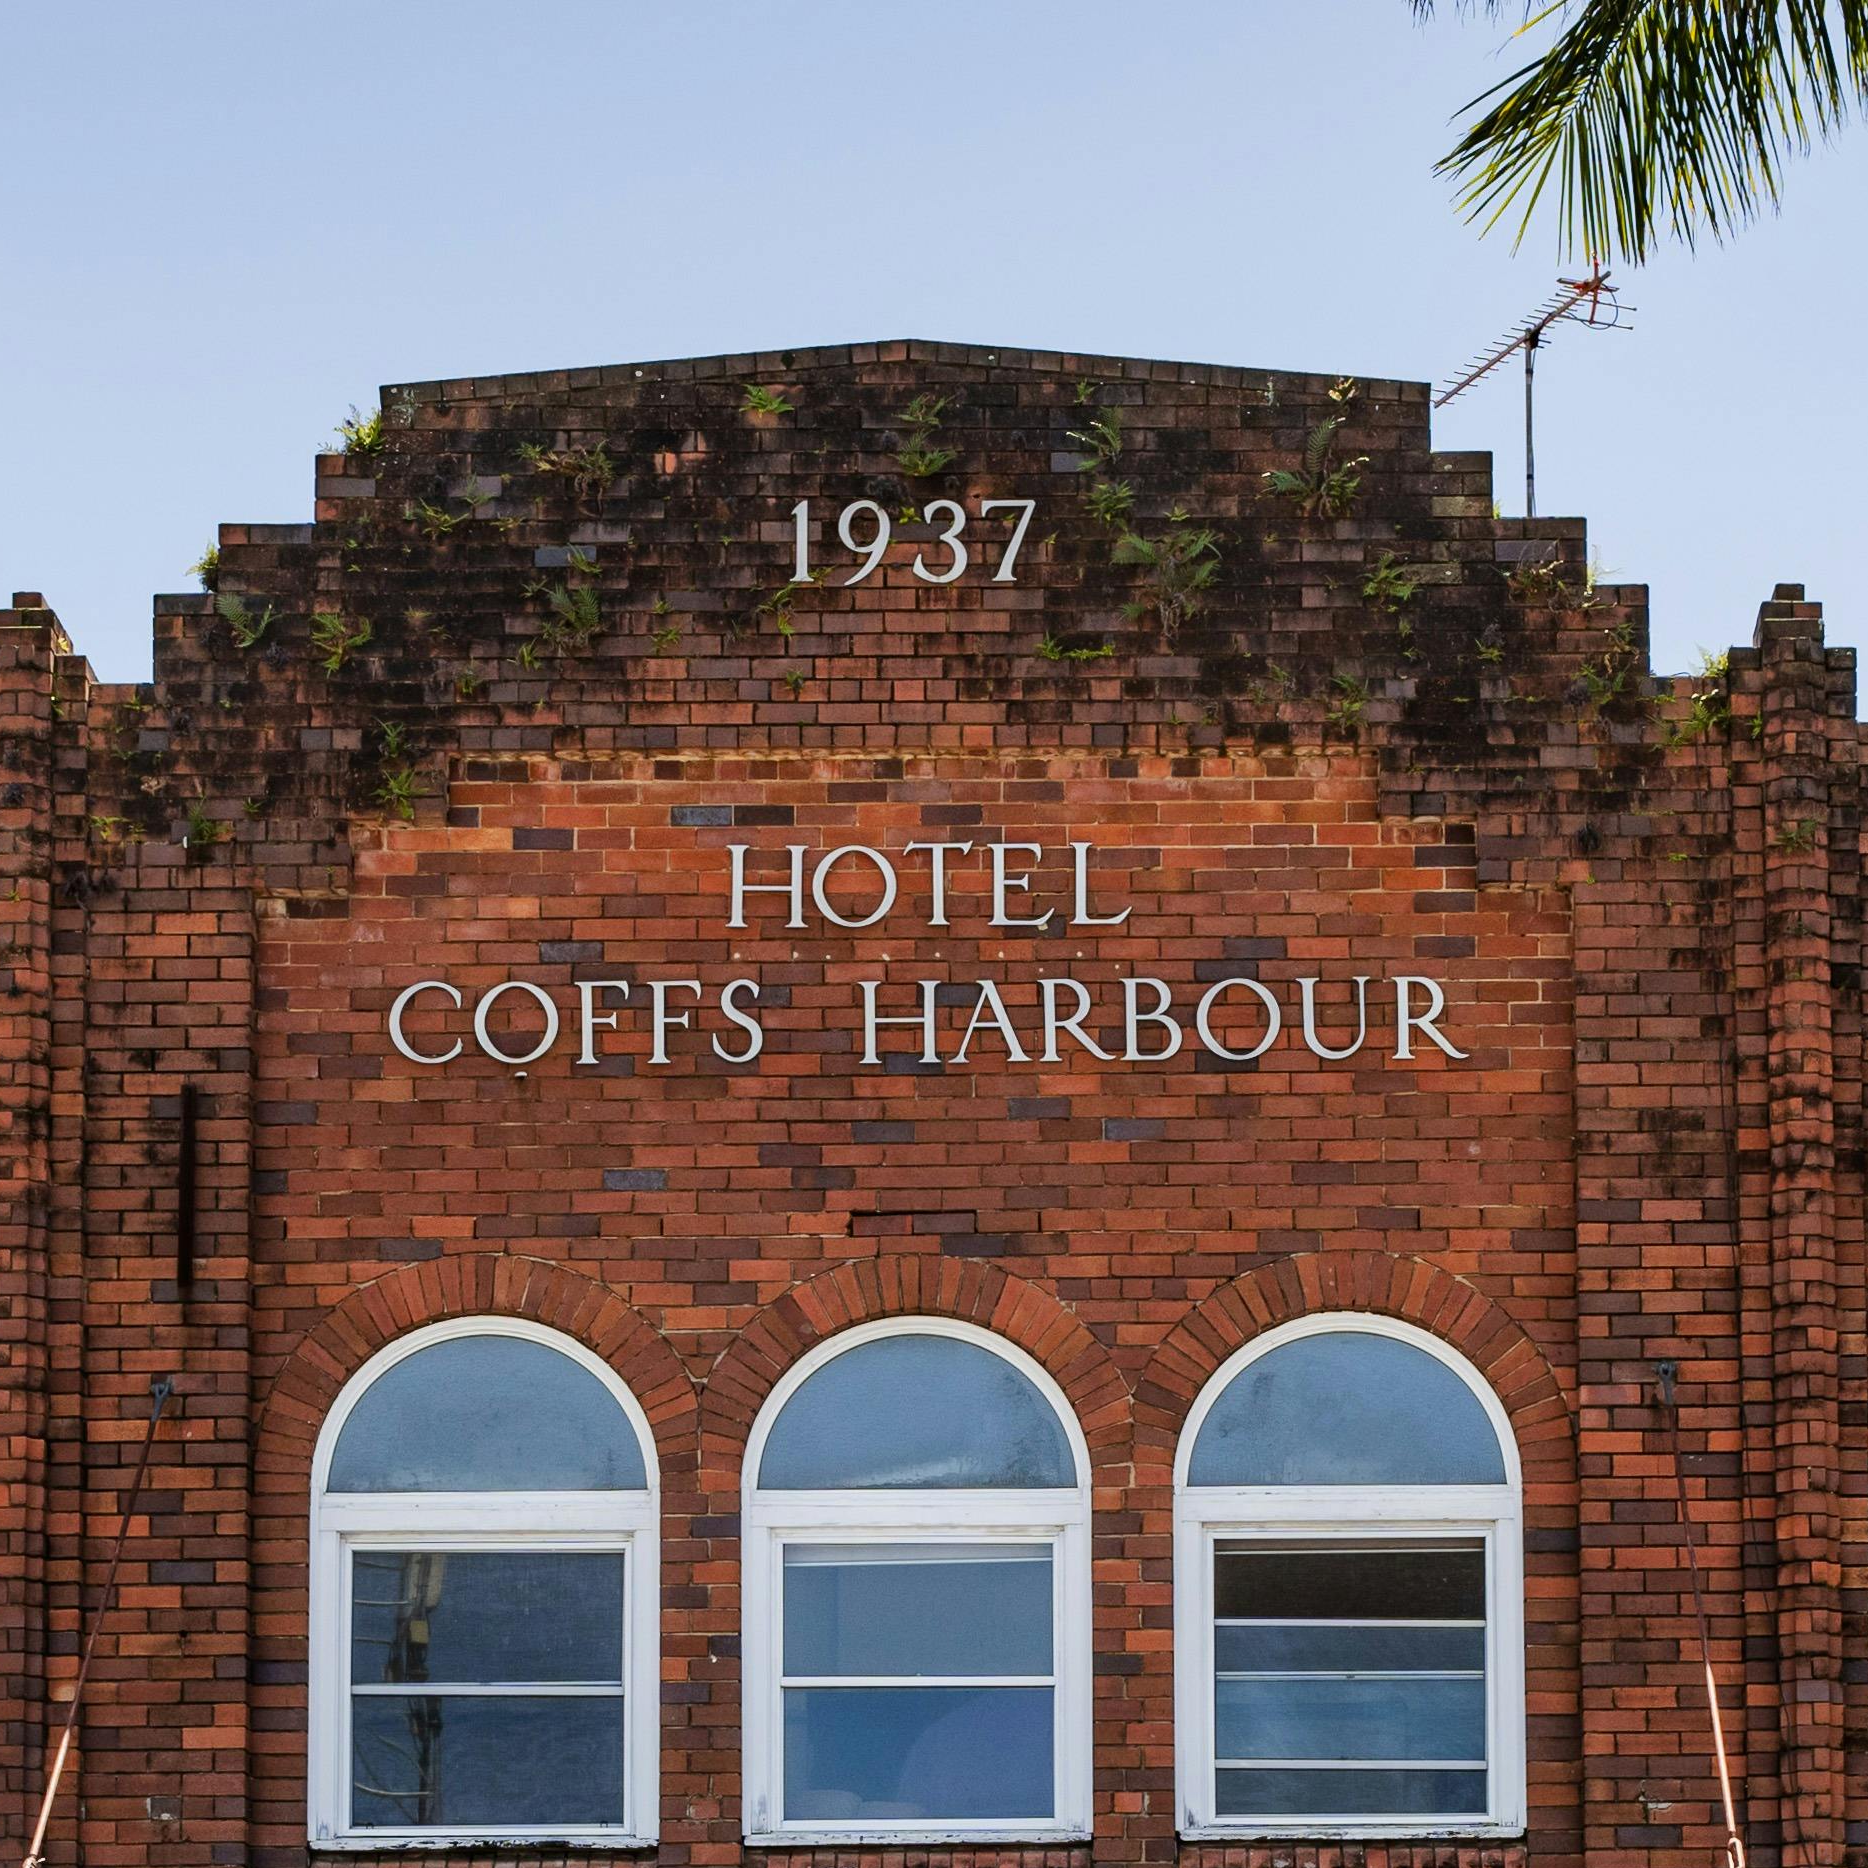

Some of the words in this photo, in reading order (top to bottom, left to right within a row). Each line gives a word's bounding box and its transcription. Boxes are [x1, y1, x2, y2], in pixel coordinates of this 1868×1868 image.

[790, 498, 1037, 586] 1937
[726, 840, 1133, 929] HOTEL
[388, 978, 765, 1066] COFFS
[857, 975, 1471, 1066] HARBOUR
